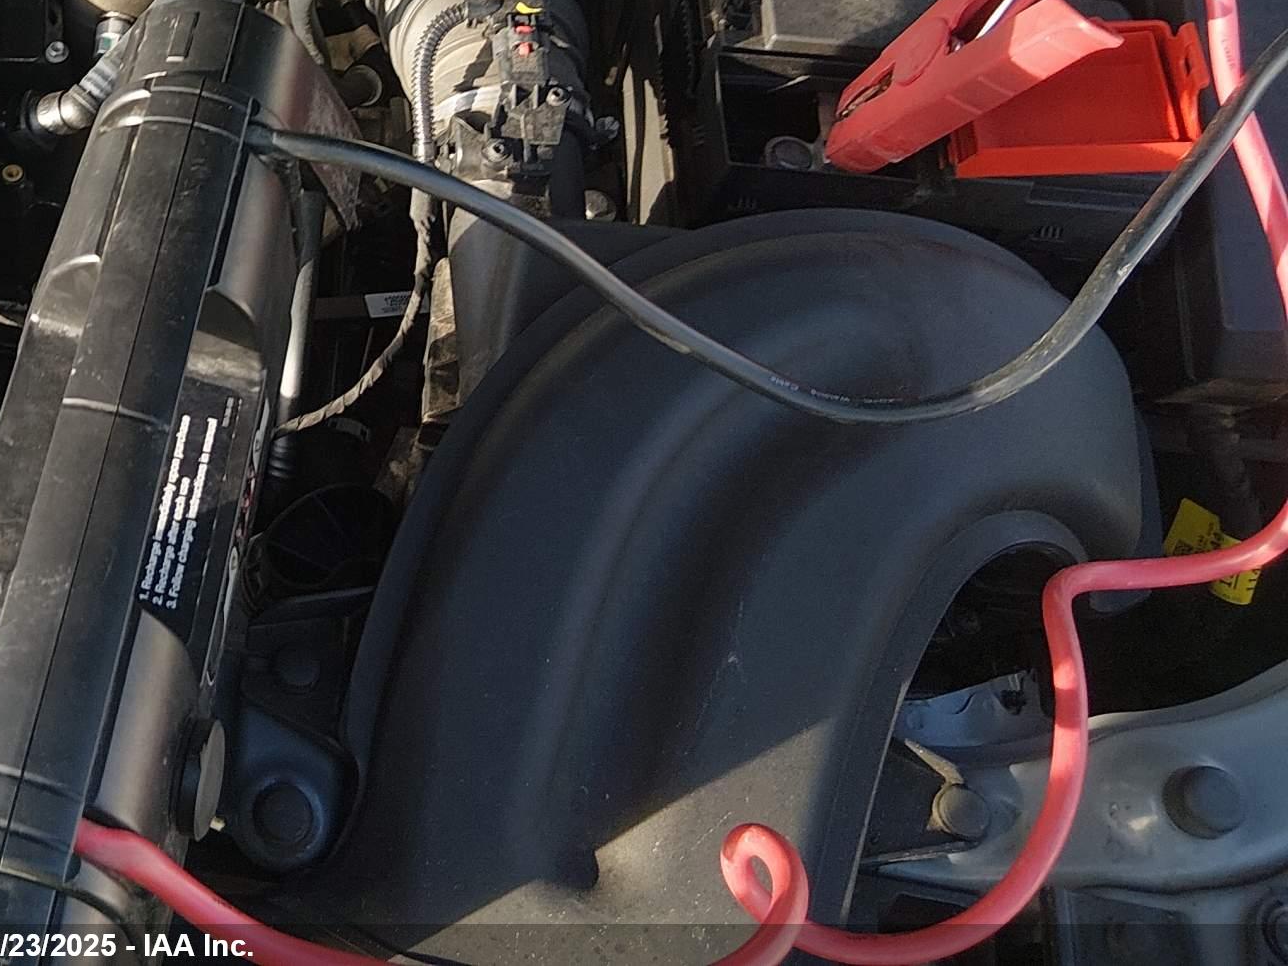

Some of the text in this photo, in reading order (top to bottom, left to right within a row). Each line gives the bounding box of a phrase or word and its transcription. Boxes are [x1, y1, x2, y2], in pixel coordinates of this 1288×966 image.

[141, 541, 161, 589] Recharge
[155, 545, 175, 593] Recharge
[167, 519, 179, 545] after
[168, 563, 184, 597] Follow
[178, 519, 196, 563] charging
